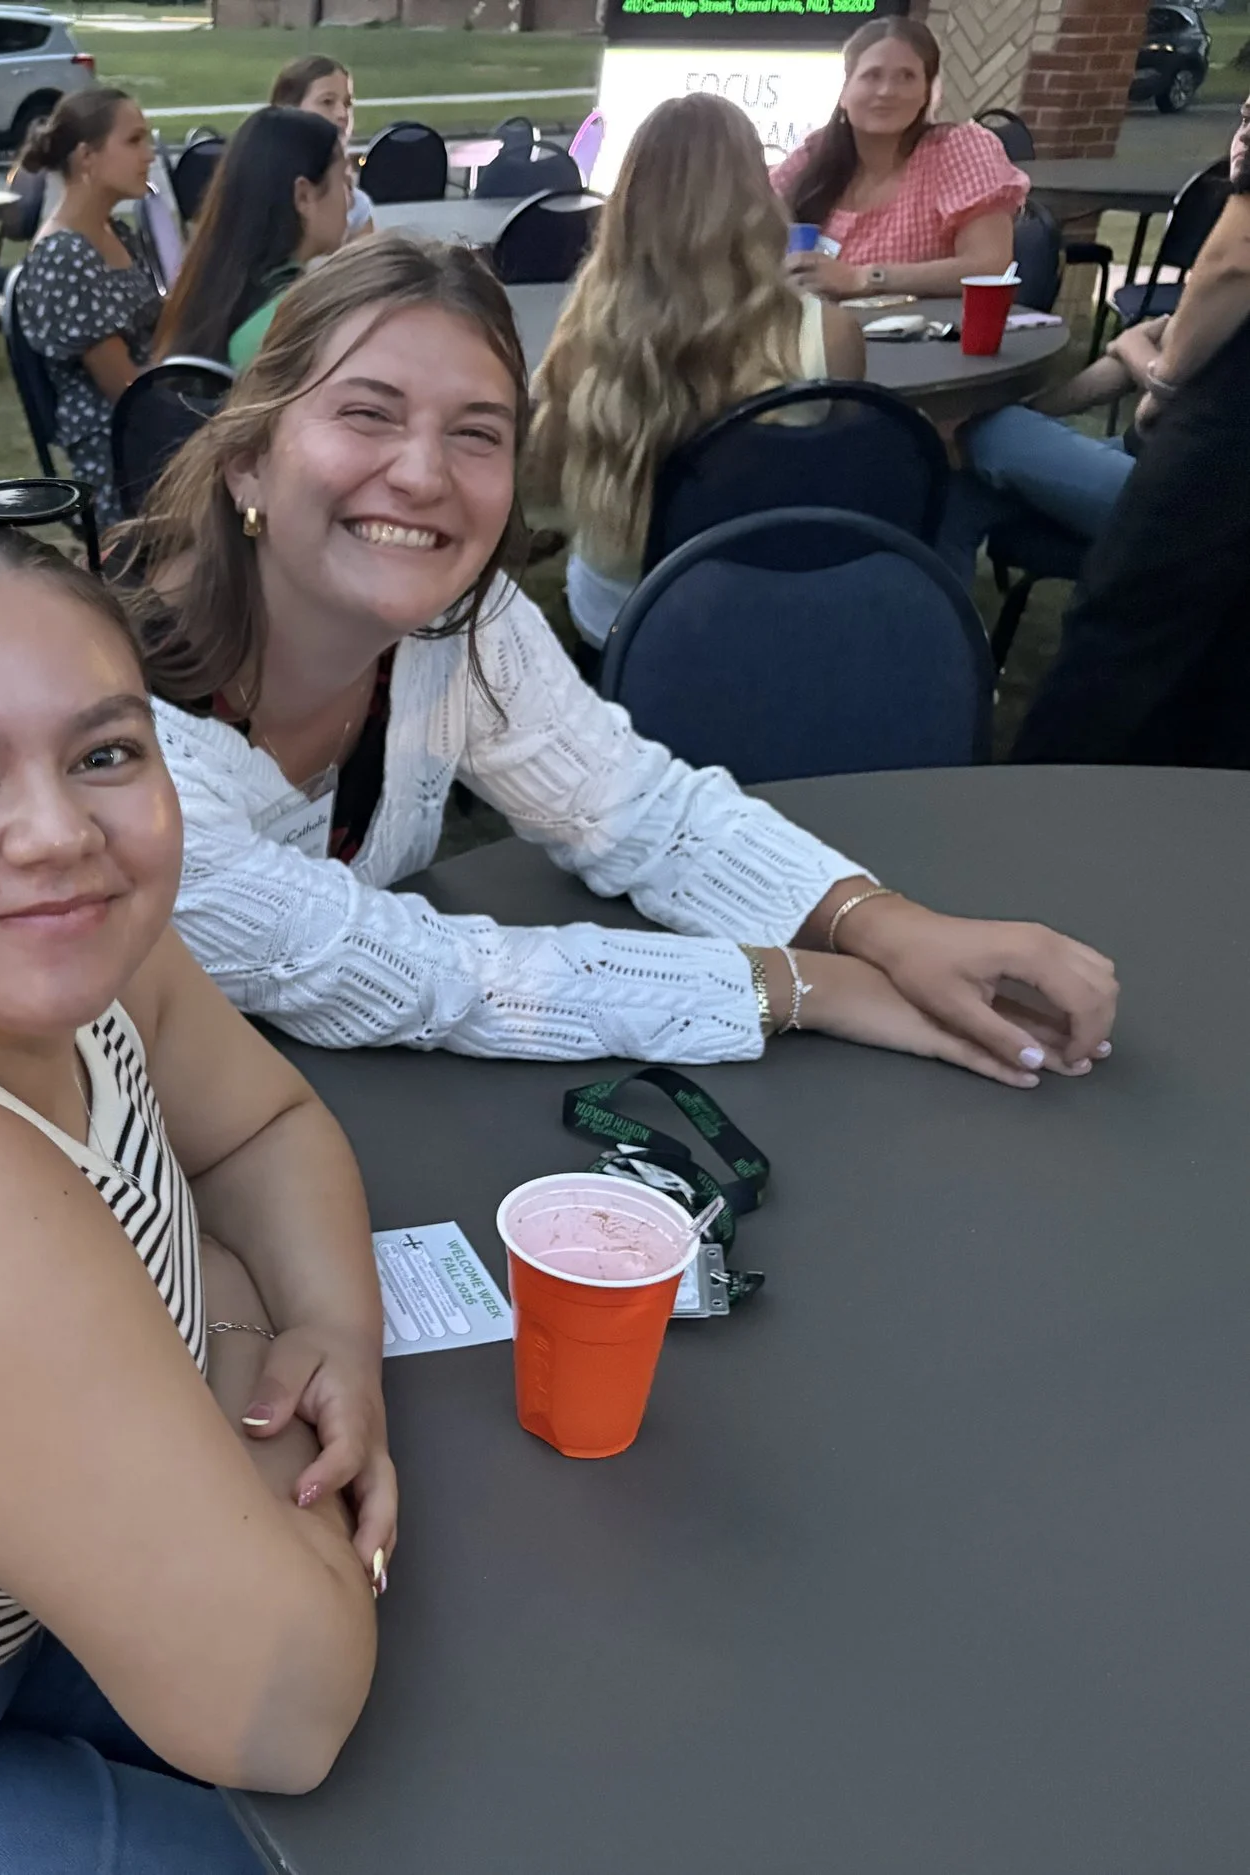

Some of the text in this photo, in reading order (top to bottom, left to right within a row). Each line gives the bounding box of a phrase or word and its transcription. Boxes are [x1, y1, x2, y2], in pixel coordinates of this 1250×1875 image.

[574, 1101, 650, 1142] NORTH DAKOTA
[439, 1257, 477, 1305] FALL 2026
[447, 1239, 504, 1319] WELCOME WEEK
